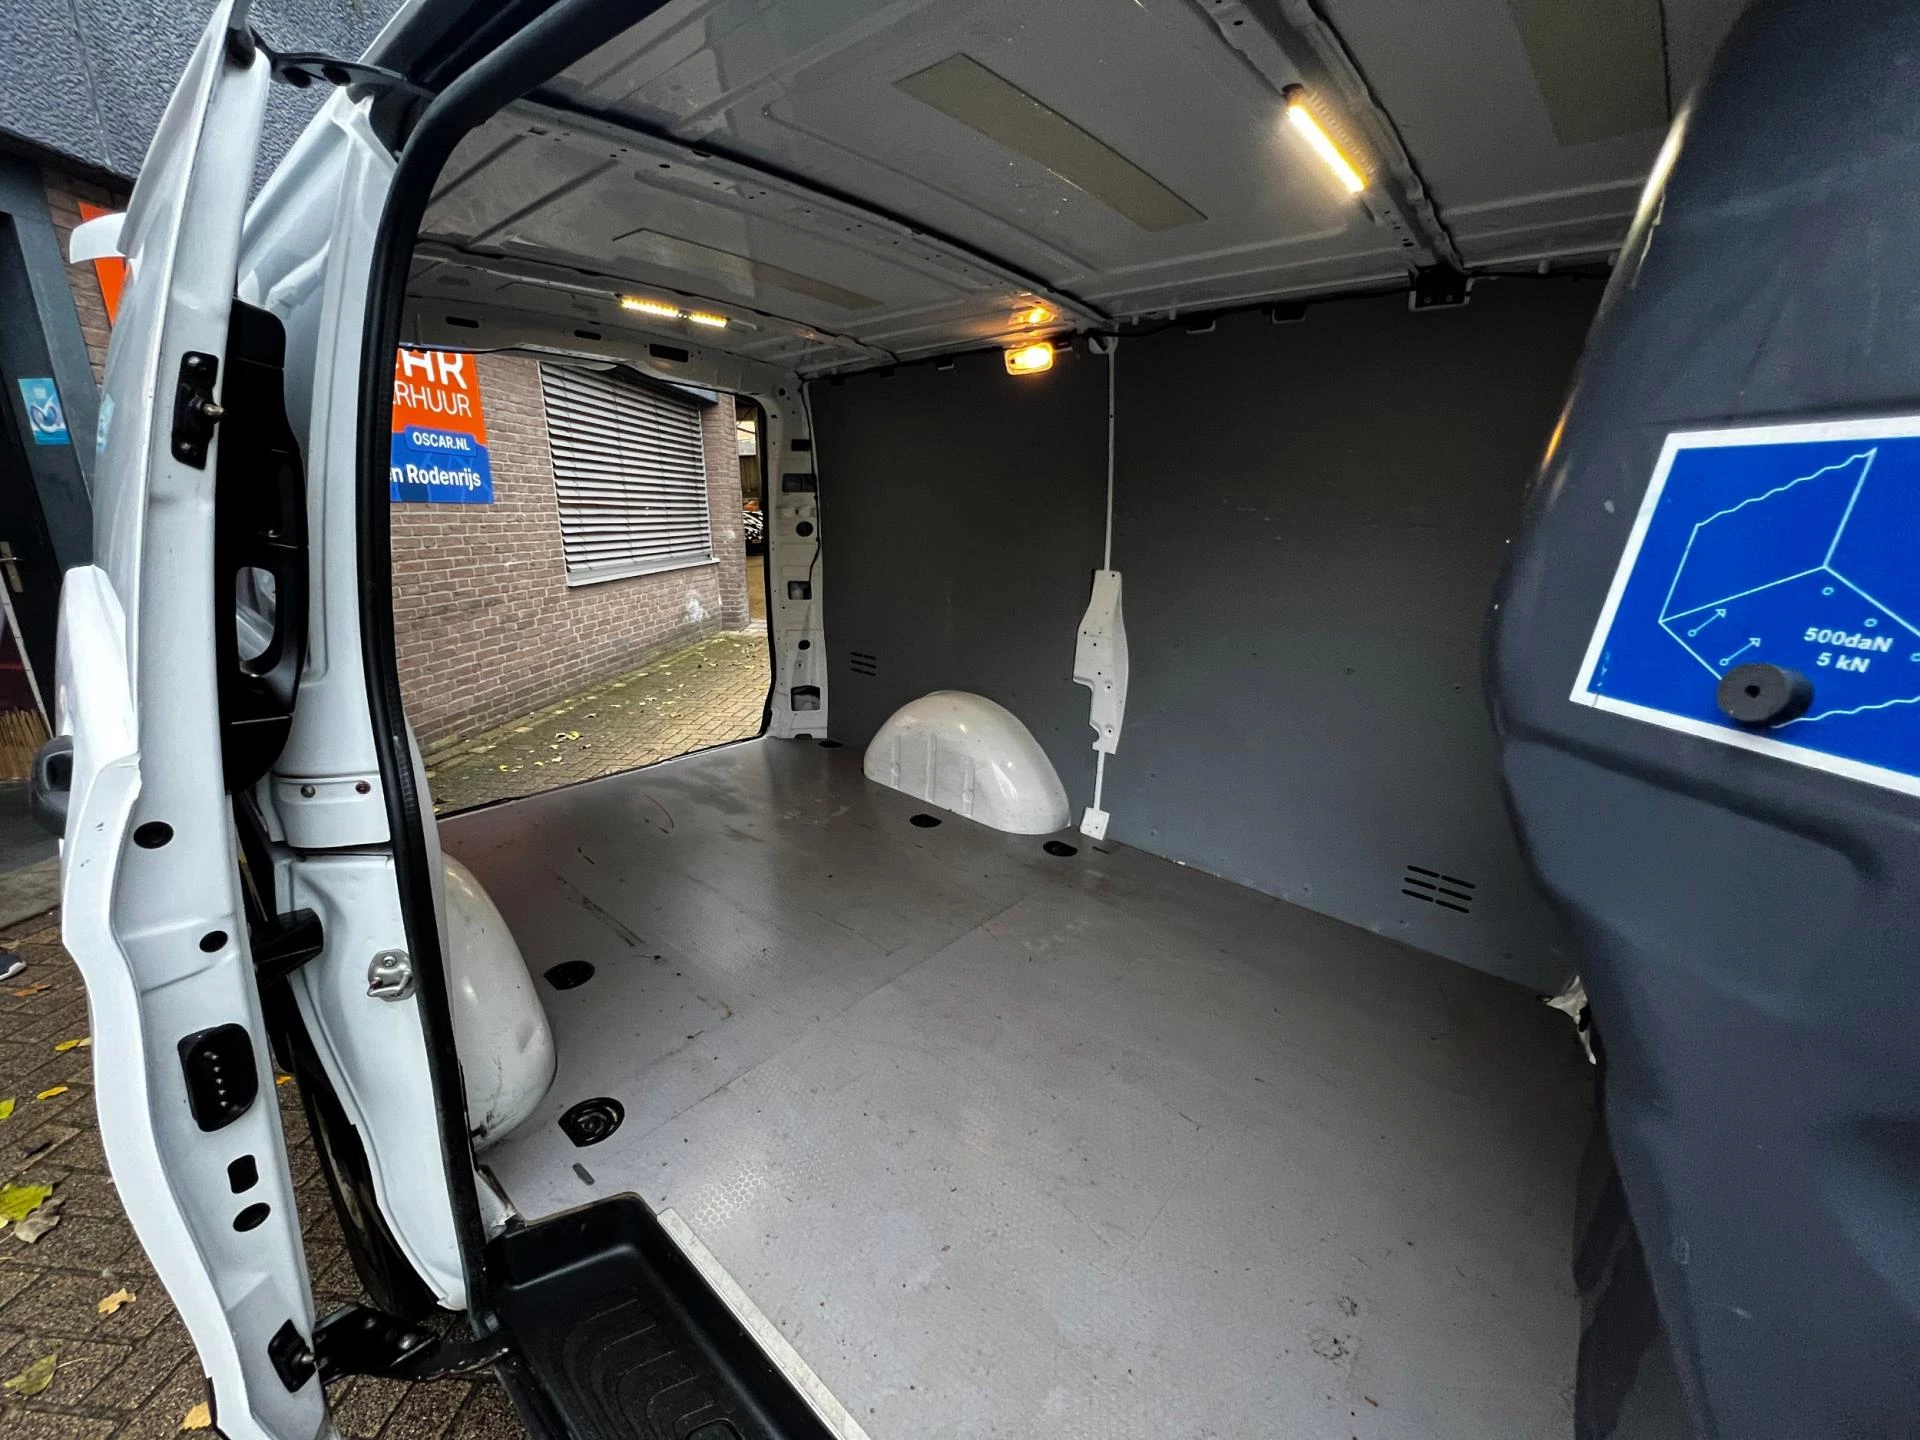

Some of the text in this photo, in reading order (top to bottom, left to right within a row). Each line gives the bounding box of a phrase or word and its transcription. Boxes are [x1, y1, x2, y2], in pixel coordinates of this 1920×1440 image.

[396, 349, 468, 389] HR
[393, 381, 472, 418] RHUUR
[412, 431, 471, 451] OSCAR.NL
[390, 463, 482, 491] n Rodenrijs
[1803, 627, 1893, 652] 500daN
[1816, 652, 1870, 673] 5 kN
